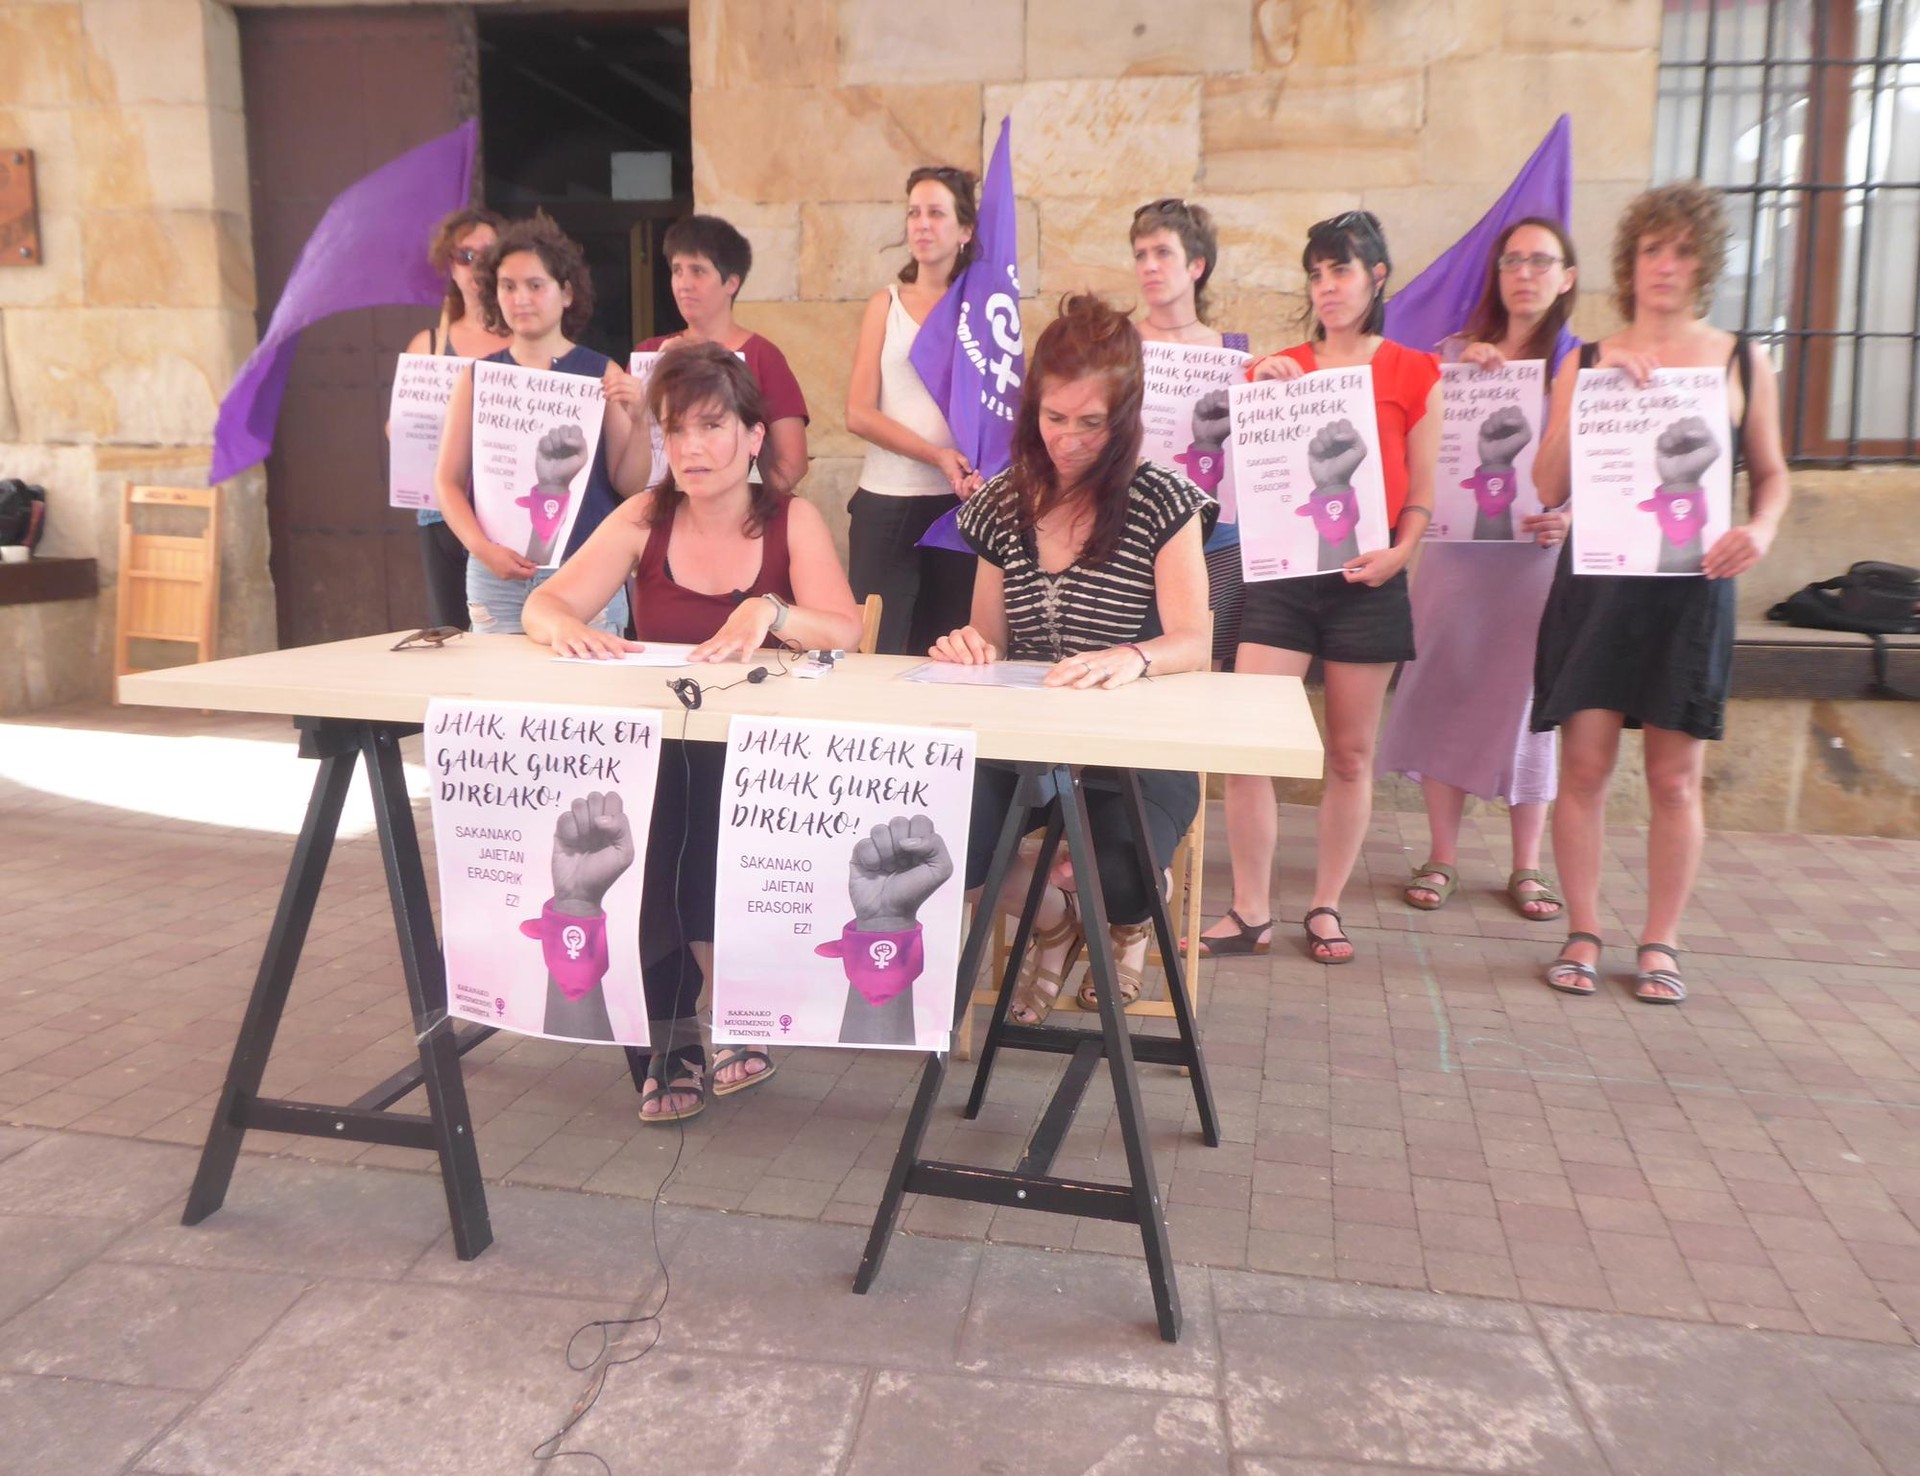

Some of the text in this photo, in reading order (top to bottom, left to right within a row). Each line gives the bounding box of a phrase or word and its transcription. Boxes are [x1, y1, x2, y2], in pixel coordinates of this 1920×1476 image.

[1148, 365, 1180, 380] AUAK
[1146, 381, 1200, 398] IRELAKO!
[1285, 378, 1336, 398] KALEAK
[1341, 375, 1363, 390] ETA
[1237, 399, 1347, 429] GAUAK GUREAK
[521, 716, 605, 746] KALEAK
[614, 721, 650, 749] ETA
[827, 734, 914, 769] KALEAK
[925, 741, 964, 771] ETA
[437, 748, 620, 783] GAUAK GUREAK
[735, 766, 929, 807] GAUAK GUREAK
[441, 781, 561, 810] DIRELAKO!
[731, 803, 860, 838] DIRELAKO!
[455, 826, 522, 842] SAKANAKO
[479, 848, 524, 864] JAIETAN
[740, 855, 812, 872] SAKANAKO
[467, 866, 522, 885] ERASORIK
[762, 880, 814, 893] JAIETAN
[747, 900, 813, 914] ERASORIK
[793, 923, 812, 935] EZ!
[724, 1019, 774, 1027] MUGIMENDU
[729, 1029, 771, 1037] FEMINISTA
